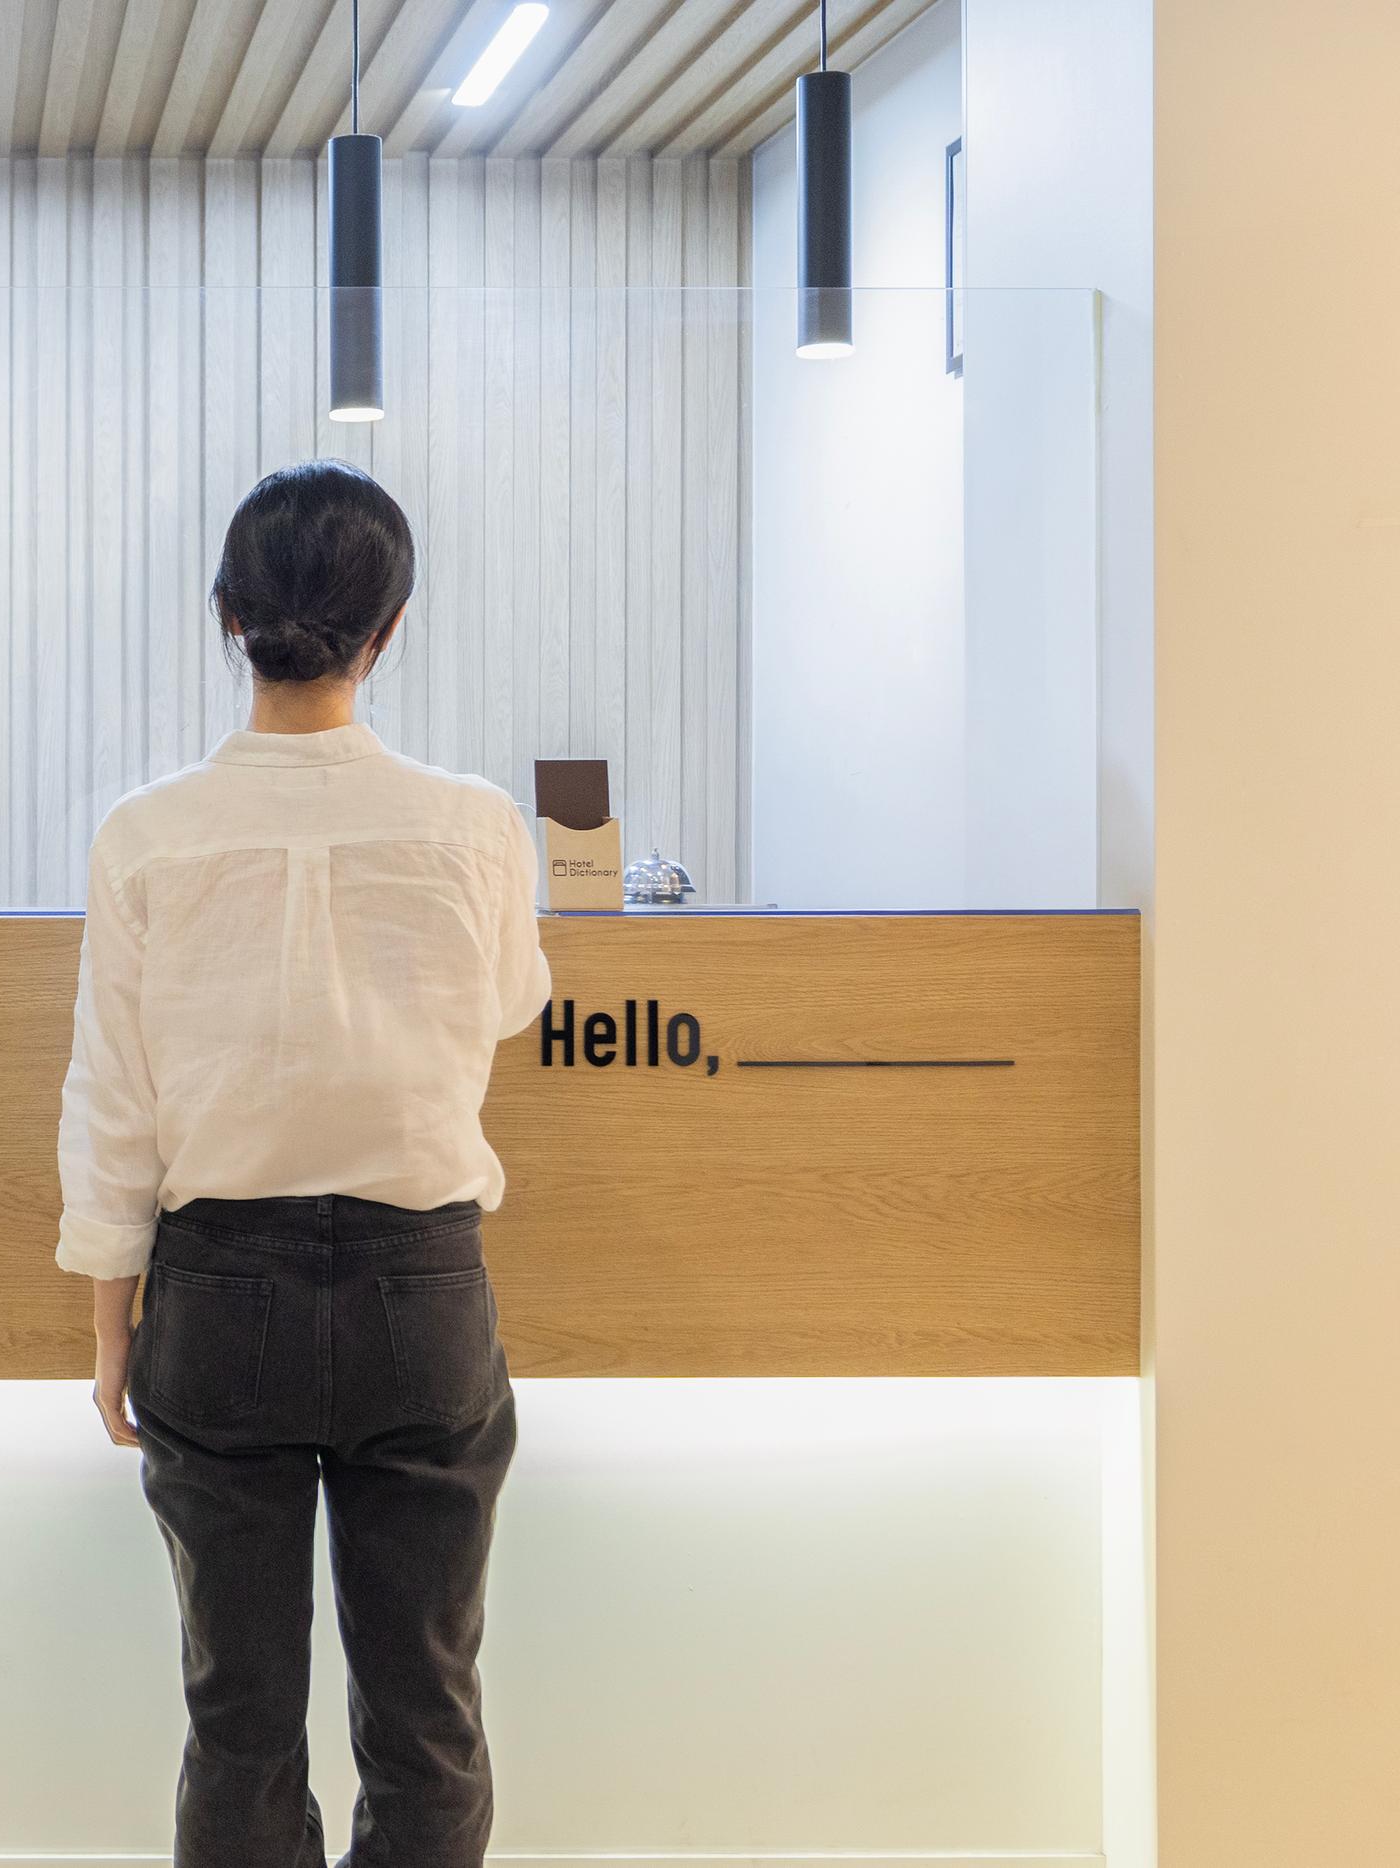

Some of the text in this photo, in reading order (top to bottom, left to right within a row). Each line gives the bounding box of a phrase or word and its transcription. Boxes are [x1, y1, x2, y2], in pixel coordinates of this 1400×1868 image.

[569, 859, 594, 868] Hotel
[569, 868, 618, 877] Dictionary
[541, 1000, 719, 1076] Hello,
